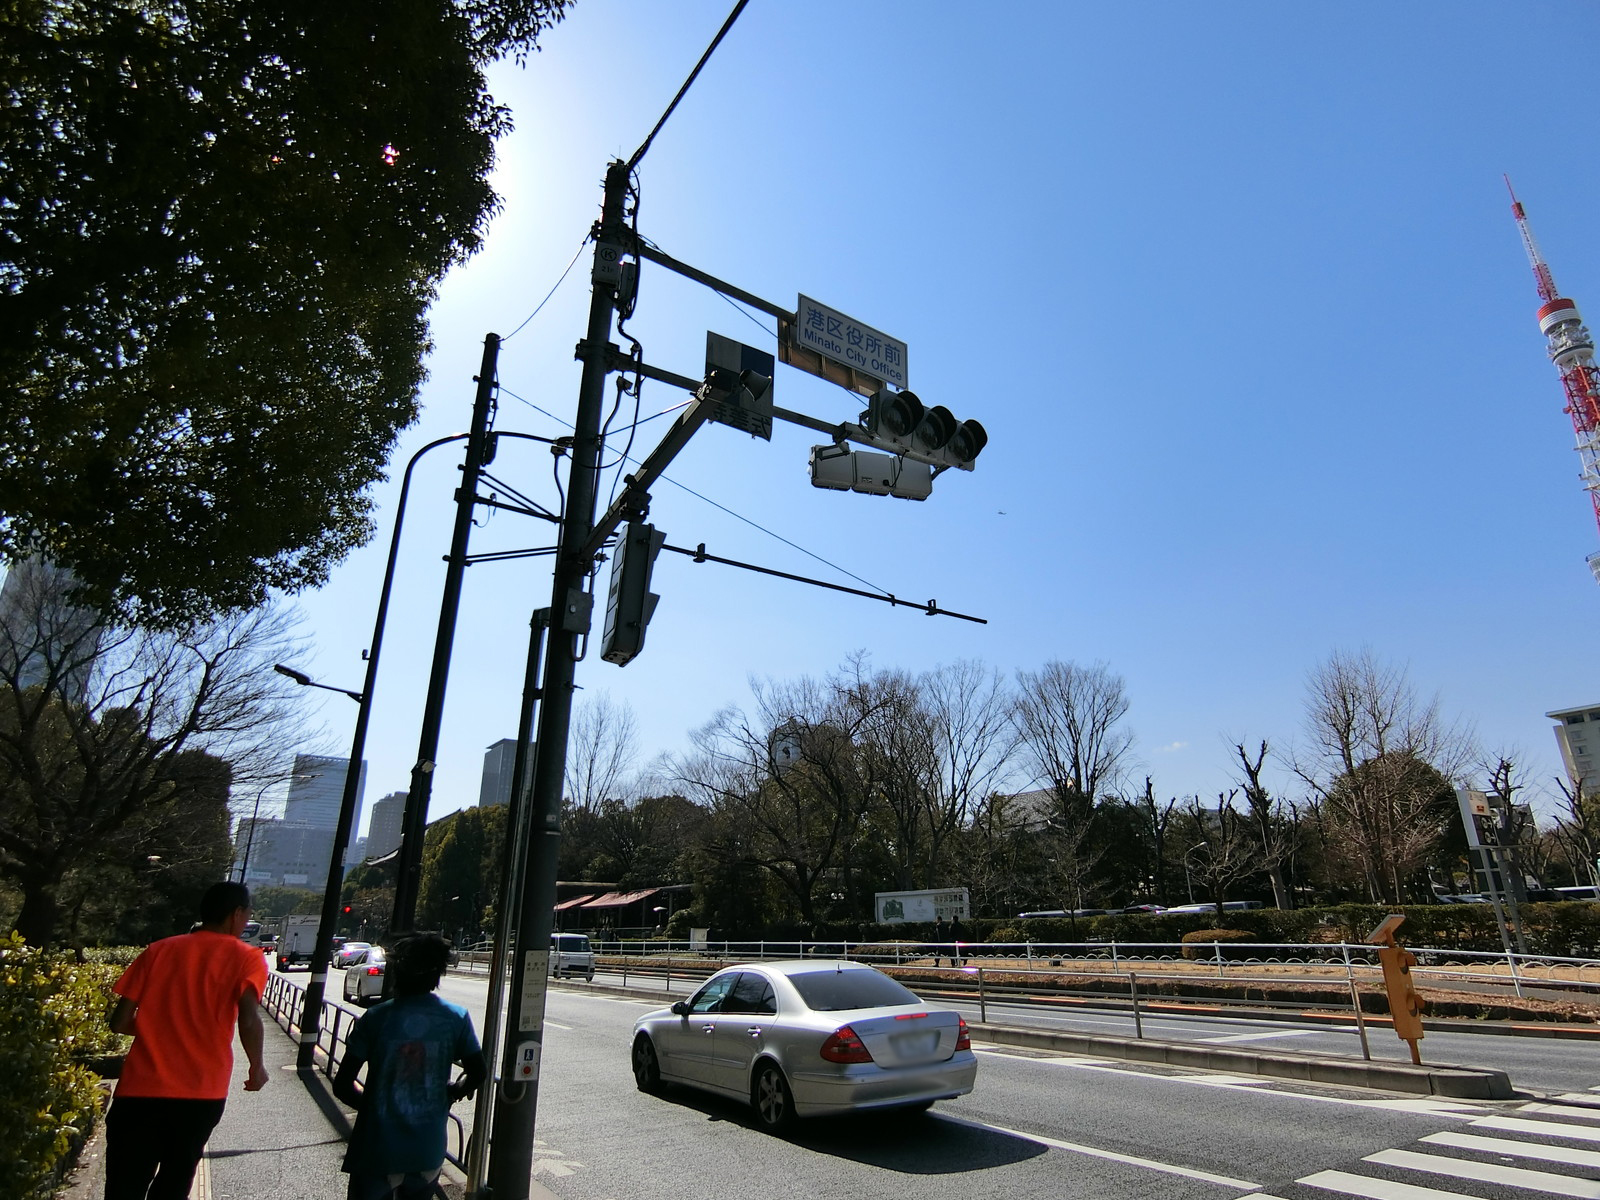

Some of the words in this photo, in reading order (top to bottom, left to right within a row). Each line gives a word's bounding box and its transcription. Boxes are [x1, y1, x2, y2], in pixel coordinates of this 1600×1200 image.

[804, 328, 841, 354] Minato
[846, 347, 867, 367] City
[871, 358, 902, 380] Office
[807, 306, 900, 367] 港区役所前
